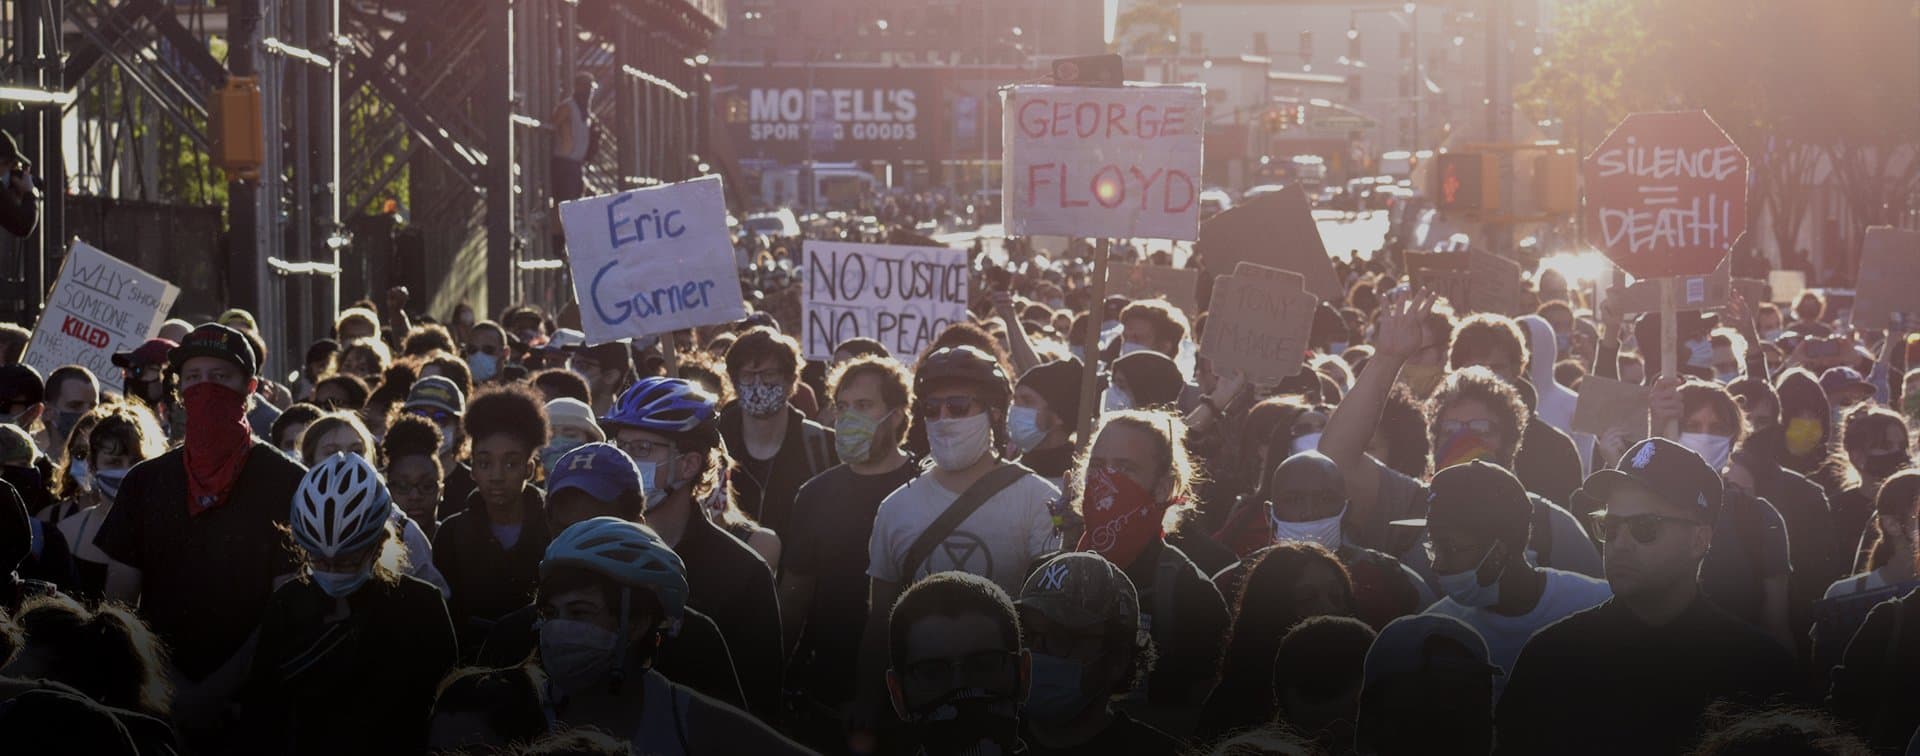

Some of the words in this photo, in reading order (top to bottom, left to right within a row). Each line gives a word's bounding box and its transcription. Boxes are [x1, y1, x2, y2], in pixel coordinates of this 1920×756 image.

[751, 123, 844, 141] SPORG
[852, 123, 917, 141] GOODS
[1018, 99, 1187, 139] GEORGE
[1026, 162, 1195, 214] FLOYD
[607, 193, 686, 248] Eric
[1599, 193, 1730, 254] DEATH!
[72, 252, 132, 297] WHY
[590, 259, 715, 325] Garner
[809, 251, 866, 301] NO
[873, 257, 967, 304] JUSTICE
[61, 283, 134, 333] SOMEONE
[61, 315, 110, 349] KILLED
[809, 309, 860, 355] NO
[877, 311, 954, 355] PEAC
[568, 453, 597, 470] H
[1038, 564, 1069, 589] NY
